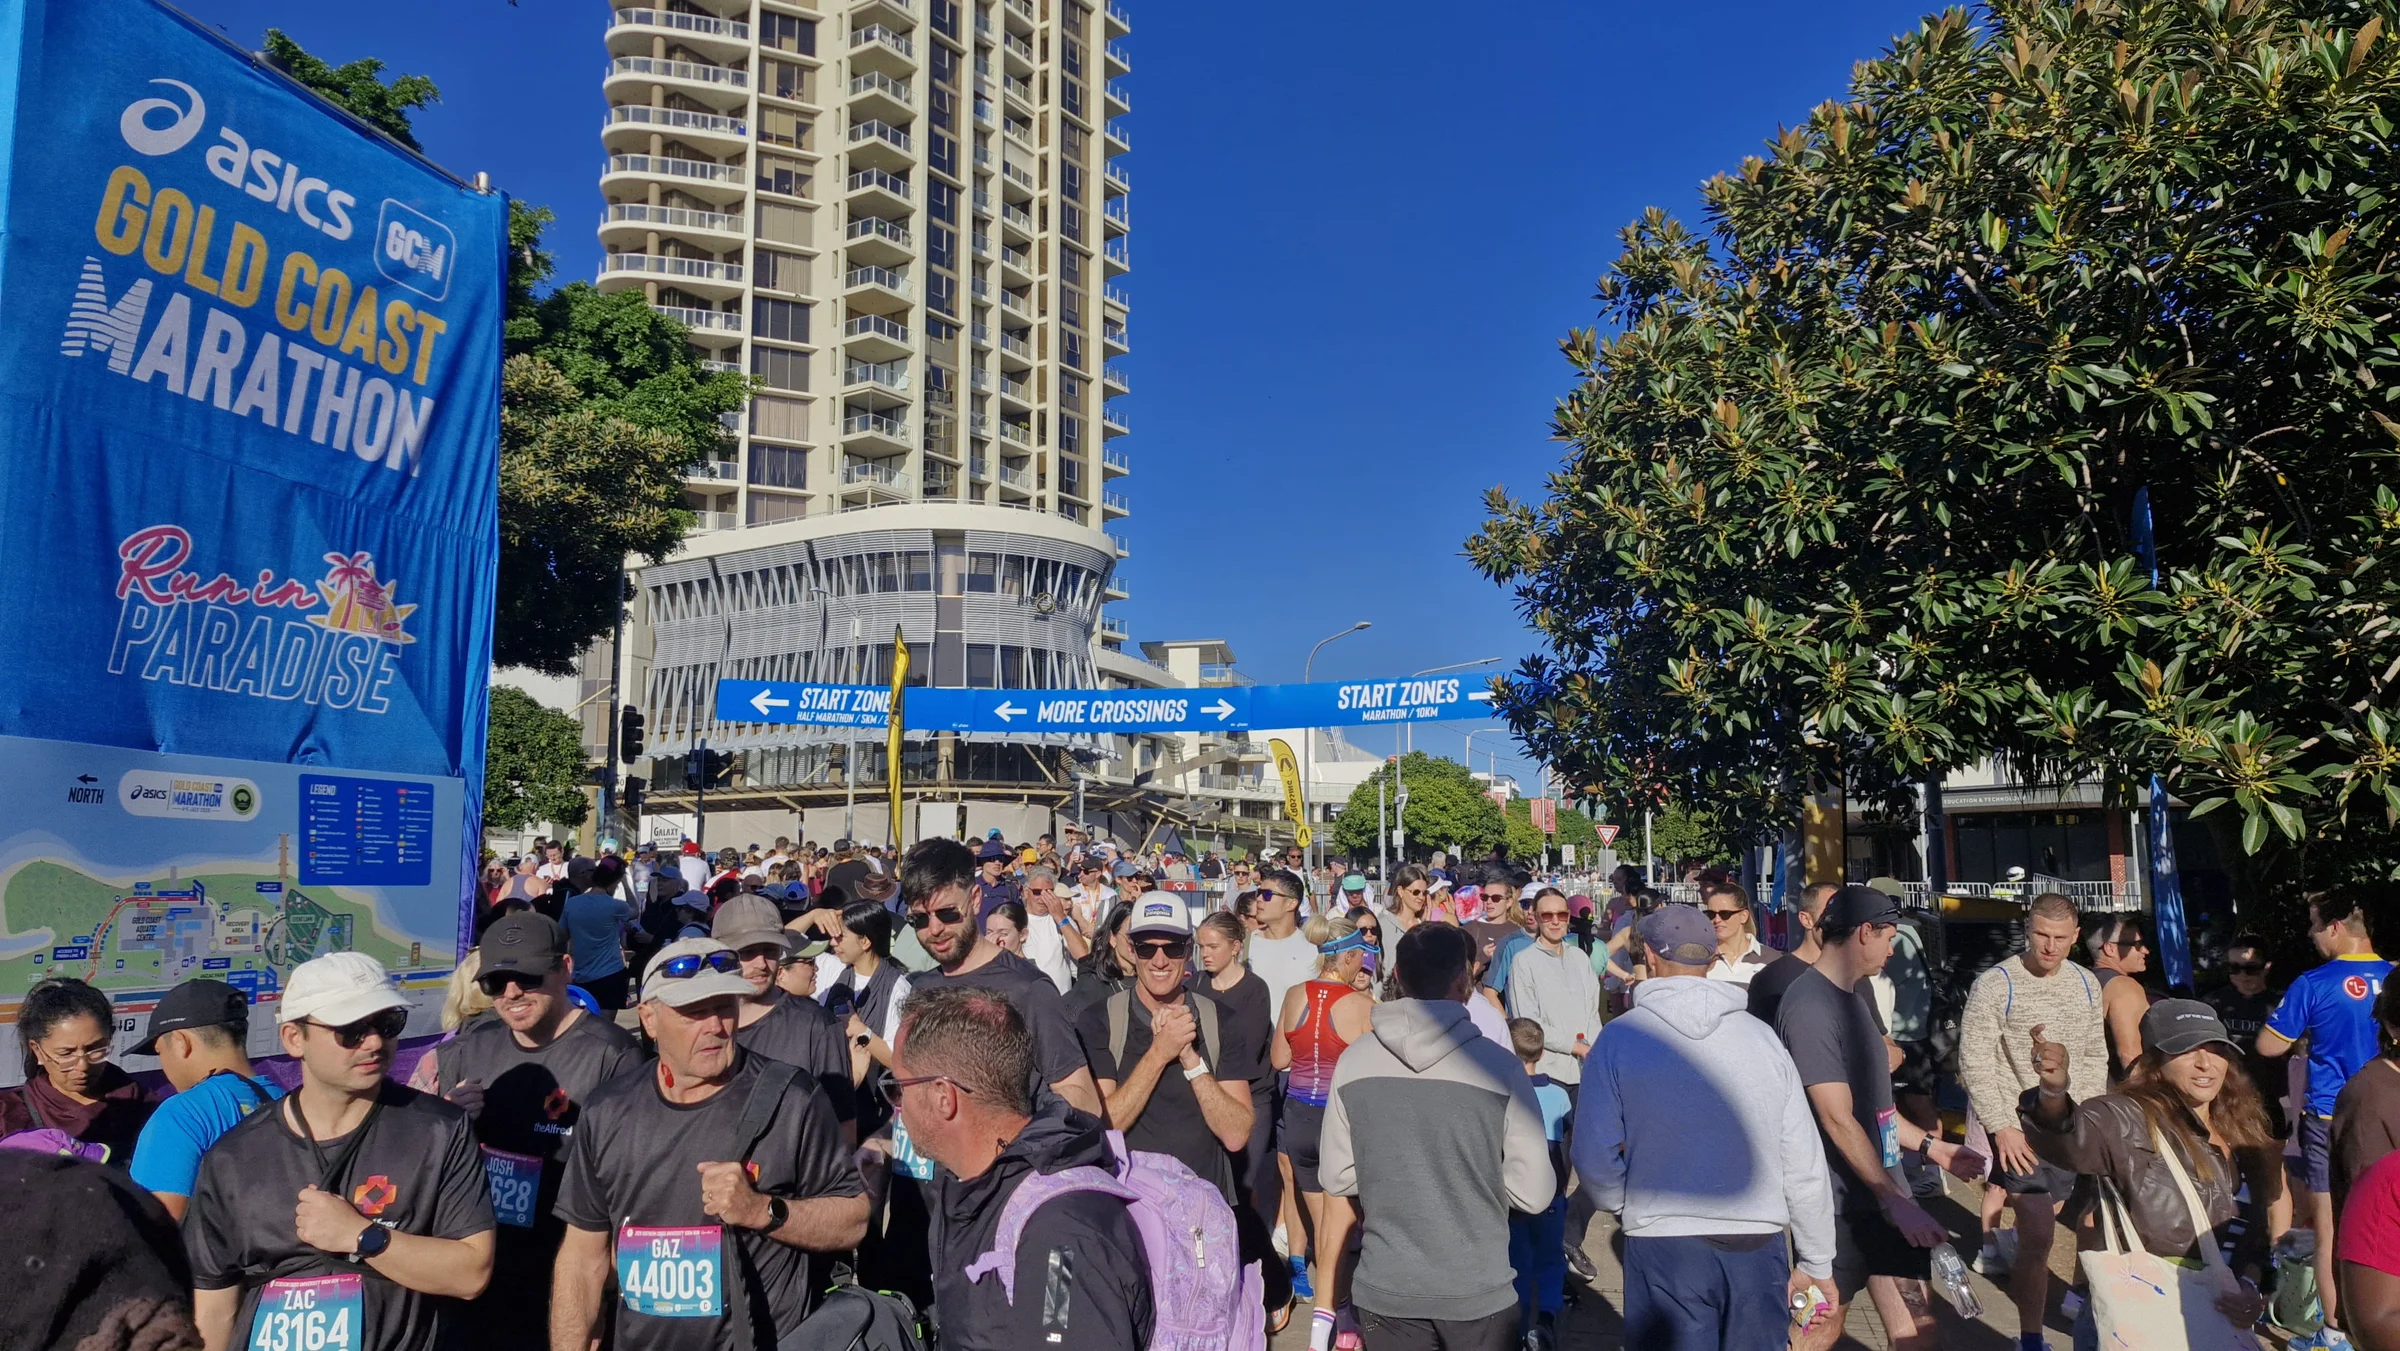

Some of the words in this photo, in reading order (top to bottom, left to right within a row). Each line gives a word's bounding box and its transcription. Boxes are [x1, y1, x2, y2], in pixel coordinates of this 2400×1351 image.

[386, 222, 446, 281] GCM
[95, 165, 268, 309] GOLD
[275, 252, 446, 386] COAST
[60, 255, 435, 478] MARATHON
[108, 598, 402, 714] PARADISE
[799, 687, 851, 711] START
[851, 689, 892, 713] ZONE
[1338, 683, 1397, 709] START
[1399, 679, 1459, 707] ZONES
[797, 711, 815, 721] HALF
[816, 713, 853, 723] MARATHON
[860, 714, 877, 724] 5KM
[1037, 700, 1087, 723] MORE
[1089, 699, 1187, 723] CROSSINGS
[1362, 709, 1407, 721] MARATHON
[1416, 707, 1438, 718] 10KM
[68, 787, 104, 804] NORTH
[173, 780, 191, 791] GOLD
[192, 781, 213, 792] COAST
[310, 784, 336, 796] LEGEND
[172, 791, 222, 807] MARATHON
[653, 827, 678, 836] GALAXY
[126, 1021, 134, 1030] P
[533, 1122, 573, 1136] theAlfred
[487, 1156, 515, 1177] JOSH
[490, 1175, 531, 1213] 628
[652, 1238, 681, 1259] GAZ
[626, 1259, 714, 1300] 44003
[283, 1289, 316, 1311] ZAC
[256, 1307, 349, 1351] 43164
